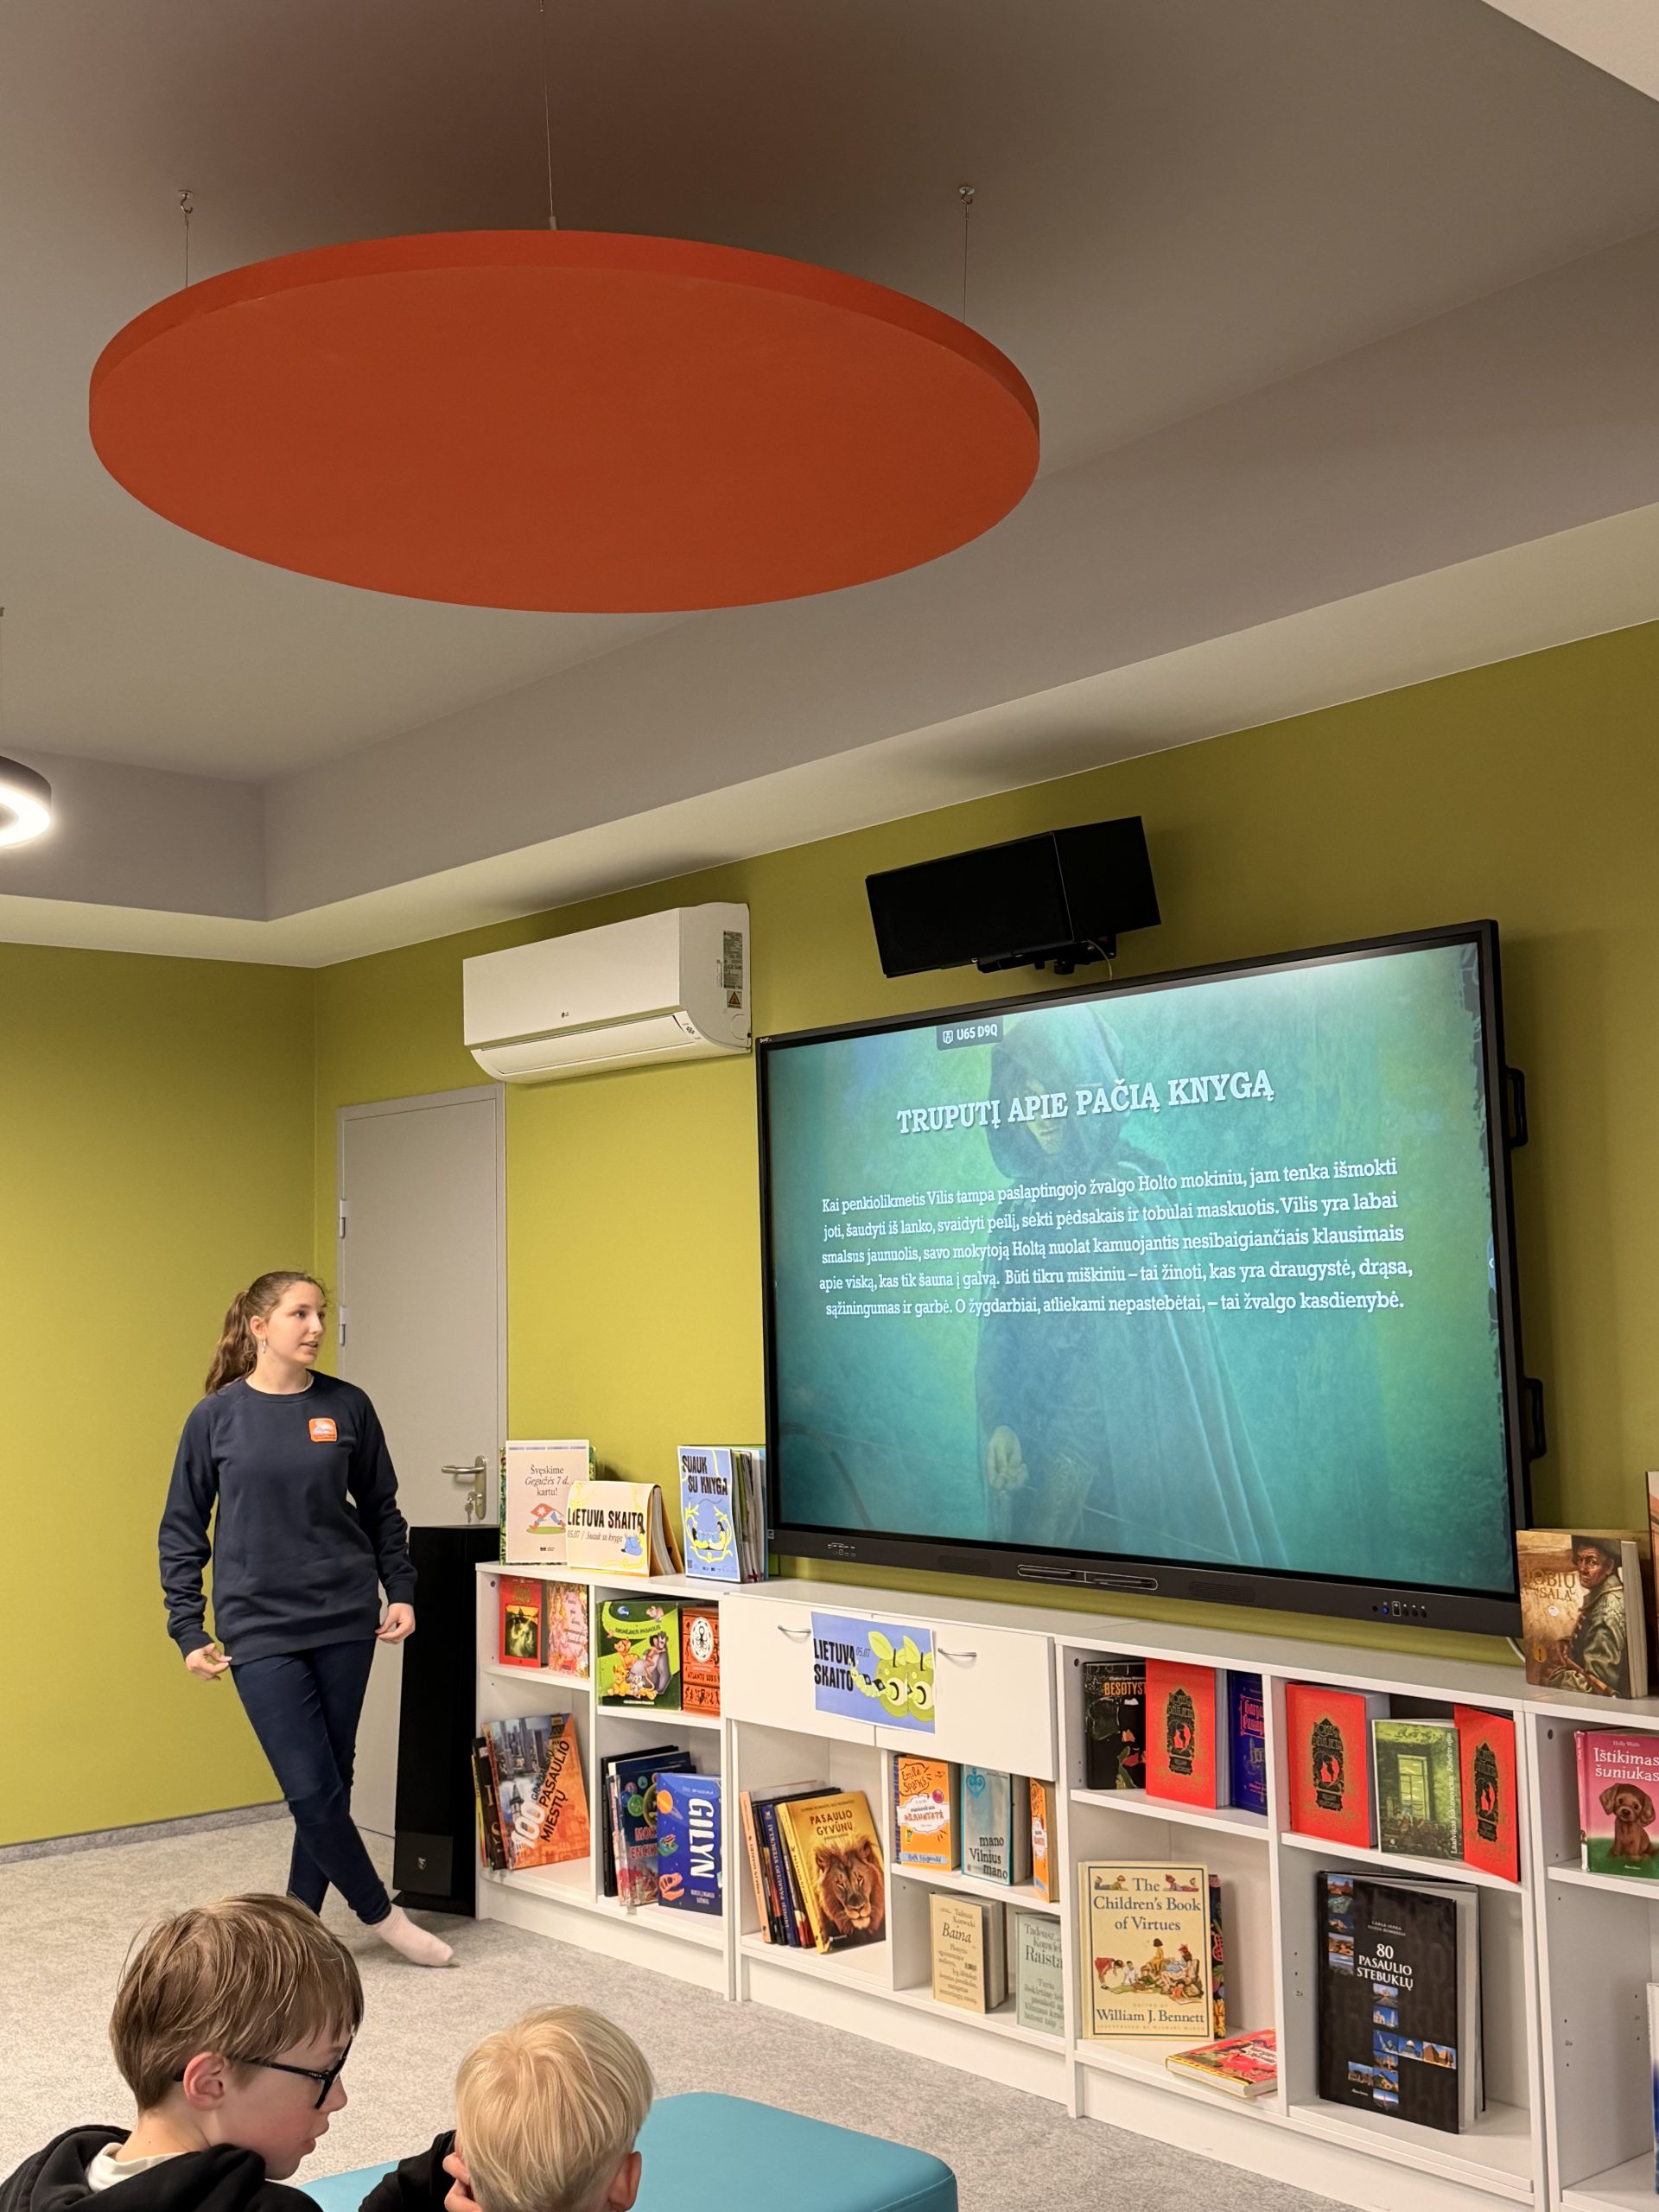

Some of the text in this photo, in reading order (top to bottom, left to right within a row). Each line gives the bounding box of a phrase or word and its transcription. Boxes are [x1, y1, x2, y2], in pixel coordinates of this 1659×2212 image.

[957, 1023, 998, 1041] U65 D9Q
[896, 1068, 1274, 1134] TRUPUTĮ APIE PAČIĄ KNYGĄ
[822, 1157, 1398, 1215] Kai penkiolikmetis Vilis tampa paslaptingojo žvalgo Holto mokiniu, jam tenka išmokti
[823, 1190, 1399, 1242] joti, šaudyti iš lanko, svaidyti peilį, sekti pėdsakais ir tobulai maskuotis. Vilis yra labai
[822, 1224, 1404, 1266] smalsus jaunuolis, savo mokytoją Holtą nuolat kamuojantis nesibaigiančiais klausimais
[819, 1275, 843, 1294] apie
[845, 1274, 878, 1293] viską,
[879, 1274, 899, 1289] kas
[901, 1273, 916, 1287] tik
[918, 1273, 953, 1287] šauna
[956, 1272, 960, 1290] į
[963, 1270, 1001, 1290] galvą.
[1005, 1269, 1030, 1285] Būti
[1033, 1268, 1065, 1283] tikru
[1067, 1266, 1127, 1282] miškiniu
[1141, 1265, 1158, 1281] tai
[1161, 1263, 1207, 1282] žinoti,
[1210, 1263, 1236, 1279] kas
[1239, 1265, 1266, 1283] yra
[1269, 1259, 1356, 1281] draugystė,
[1358, 1258, 1413, 1280] drąsa,
[826, 1300, 900, 1319] sąžiningumas
[903, 1300, 912, 1314] ir
[915, 1299, 953, 1318] garbė.
[955, 1298, 966, 1313] O
[969, 1297, 1041, 1317] žygdarbiai,
[1043, 1295, 1106, 1313] atliekami
[1109, 1294, 1205, 1315] nepastebėtai,
[1221, 1293, 1241, 1310] tai
[1243, 1292, 1296, 1314] žvalgo
[1300, 1290, 1404, 1313] kasdienybė.
[531, 1464, 564, 1476] Švęskime
[525, 1476, 555, 1487] Gegužės
[556, 1476, 562, 1484] 7
[688, 1475, 728, 1496] SU KNYGA
[537, 1487, 558, 1496] kartu!
[568, 1508, 644, 1531] LIETUVA SKAITO
[1540, 1587, 1573, 1601] SALA
[813, 1638, 855, 1668] LIETUVA
[855, 1646, 871, 1658] 05.07
[813, 1663, 854, 1692] SKAITO
[1593, 1747, 1659, 1766] Ištikimas
[539, 1740, 570, 1808] PASAULIO
[1595, 1764, 1659, 1782] šuniukas
[903, 1776, 927, 1795] Sparks
[512, 1800, 545, 1849] 100
[541, 1789, 569, 1843] MIESTŲ
[810, 1809, 853, 1825] PASAULIO
[689, 1798, 715, 1878] GILYN
[979, 1836, 1004, 1847] mano
[969, 1847, 1001, 1864] Vilnius
[983, 1866, 1007, 1879] mano
[1132, 1878, 1160, 1891] The
[1093, 1896, 1201, 1911] Children's Book
[942, 1922, 971, 1943] Baina
[1115, 1916, 1181, 1931] of Virtues
[1376, 1943, 1394, 1960] 80
[1358, 1955, 1412, 1976] PASAULIO
[1357, 1967, 1414, 1991] STEBUKLŲ
[1096, 2008, 1204, 2024] William J. Bennett
